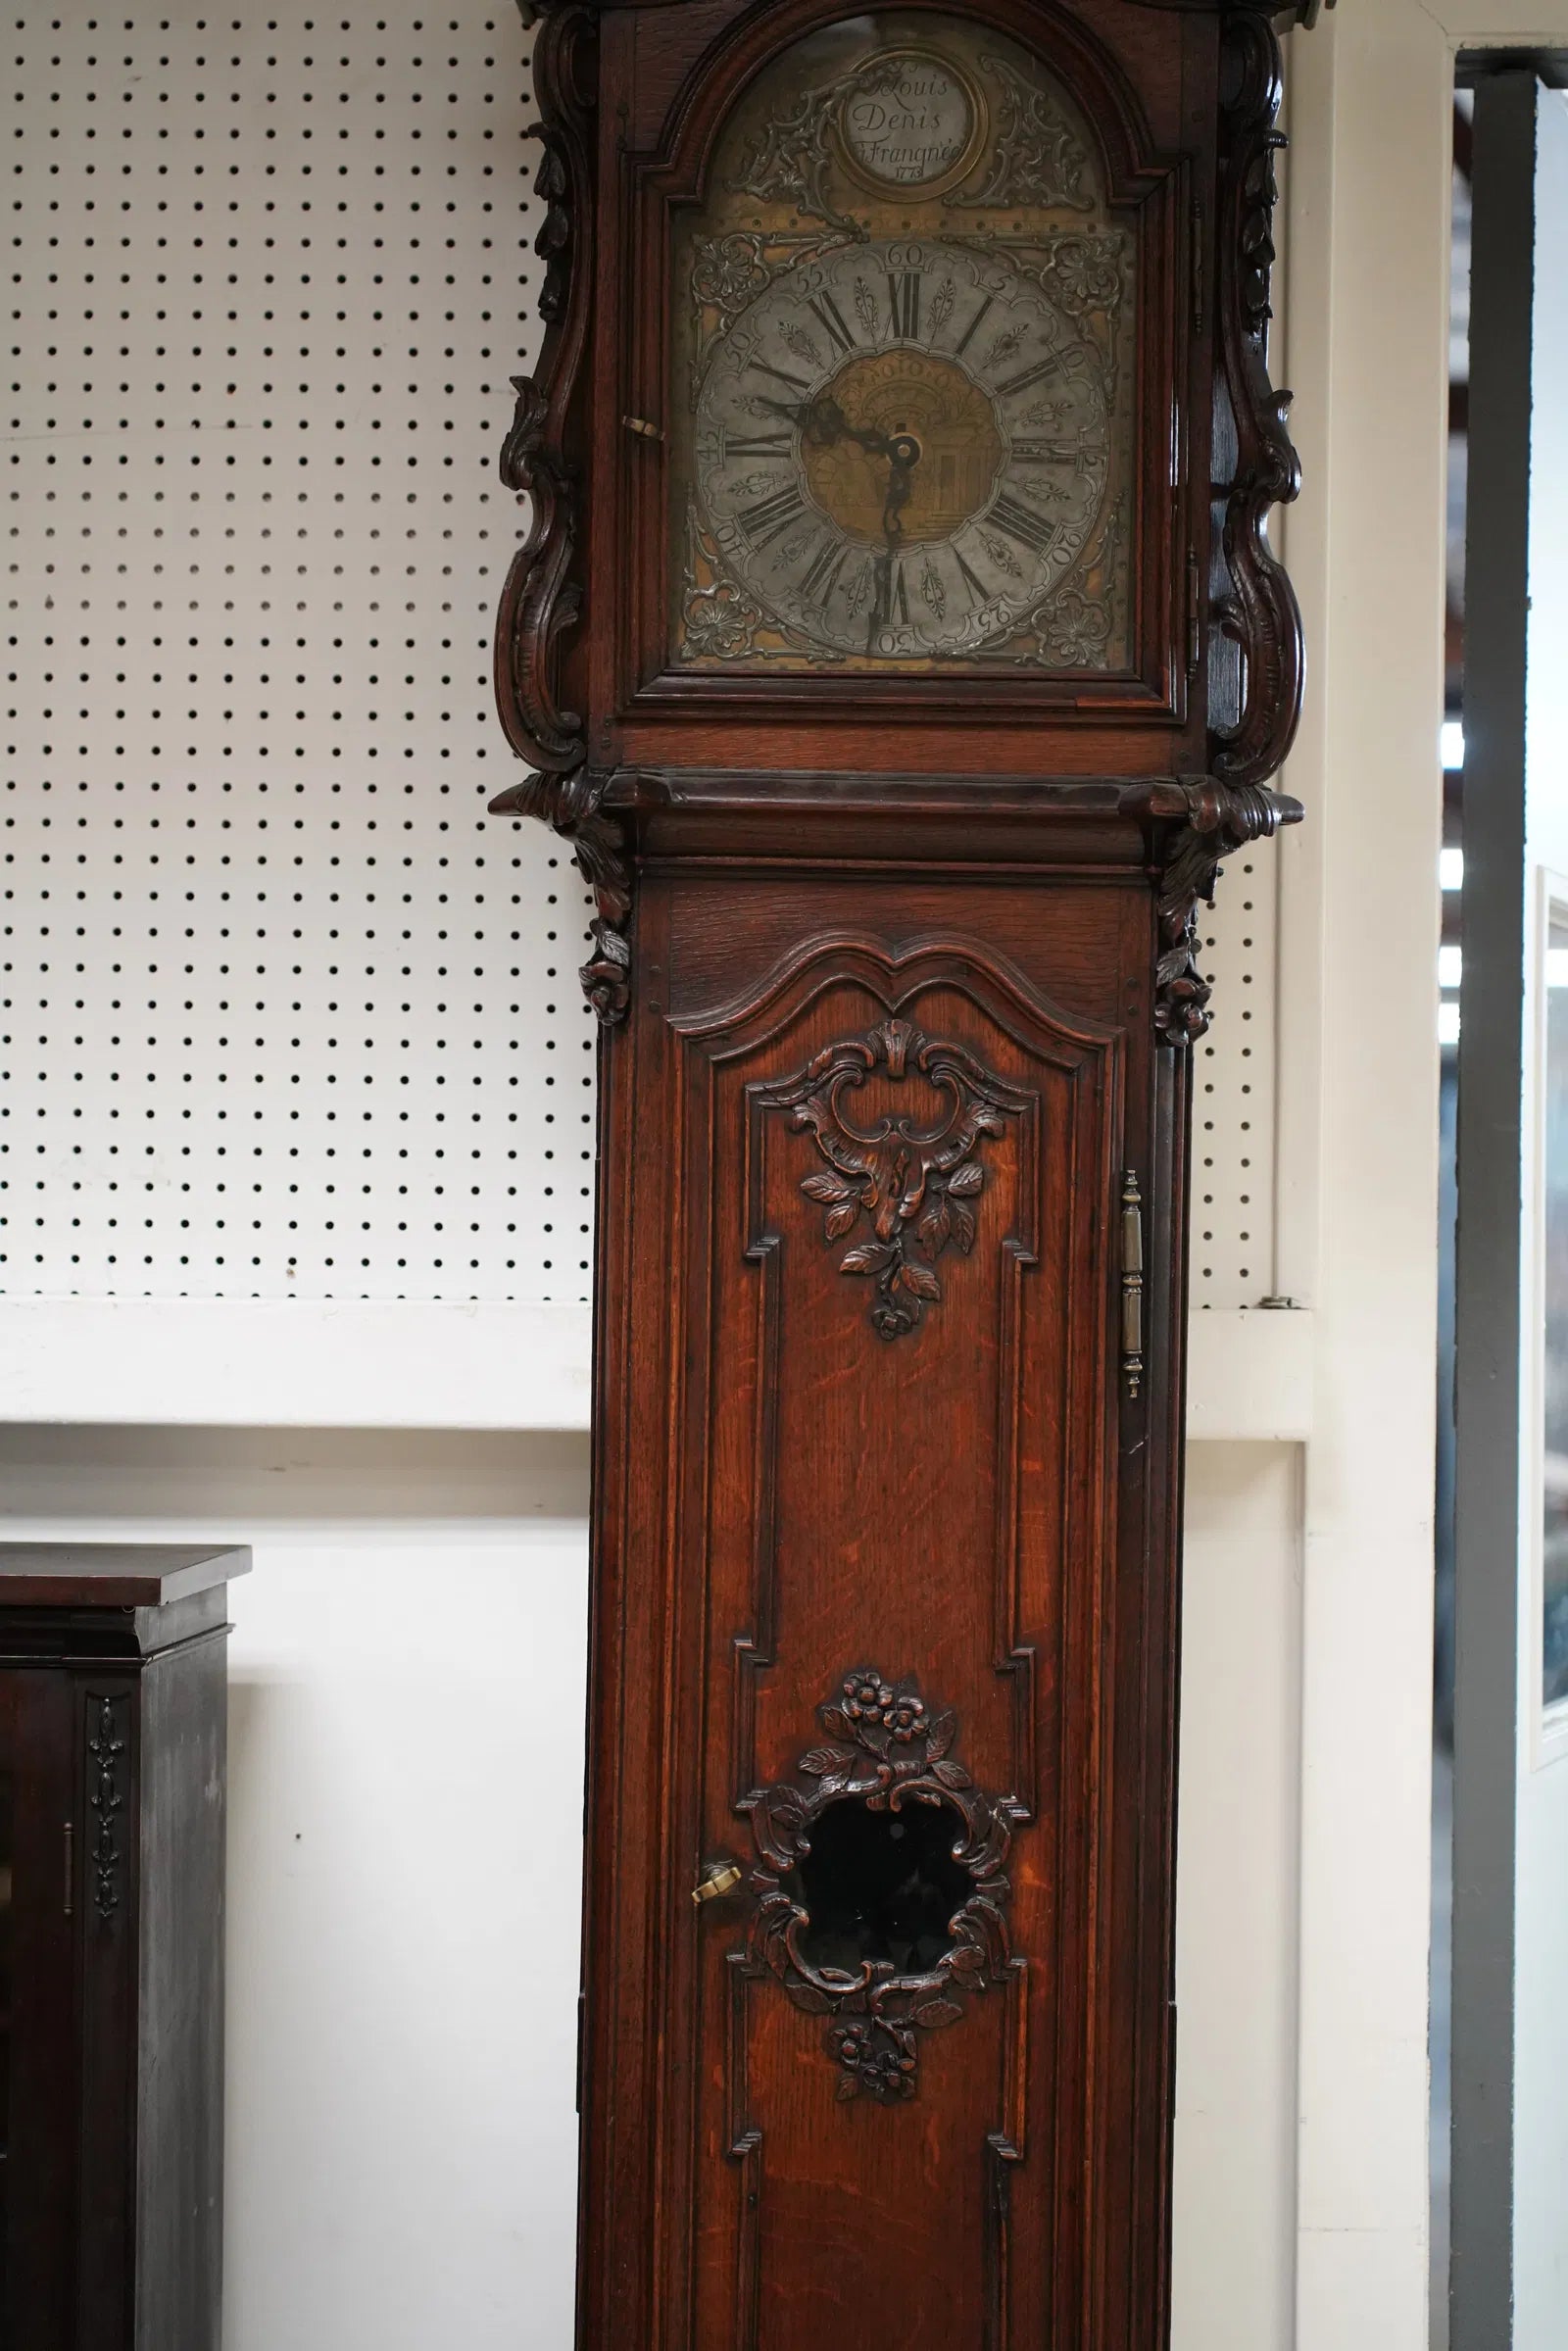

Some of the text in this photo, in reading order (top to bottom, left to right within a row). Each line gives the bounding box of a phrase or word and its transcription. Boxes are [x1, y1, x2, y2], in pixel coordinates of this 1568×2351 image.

[852, 103, 942, 131] Denis
[887, 245, 923, 267] 60
[884, 272, 921, 340] XII
[877, 633, 911, 655] 30
